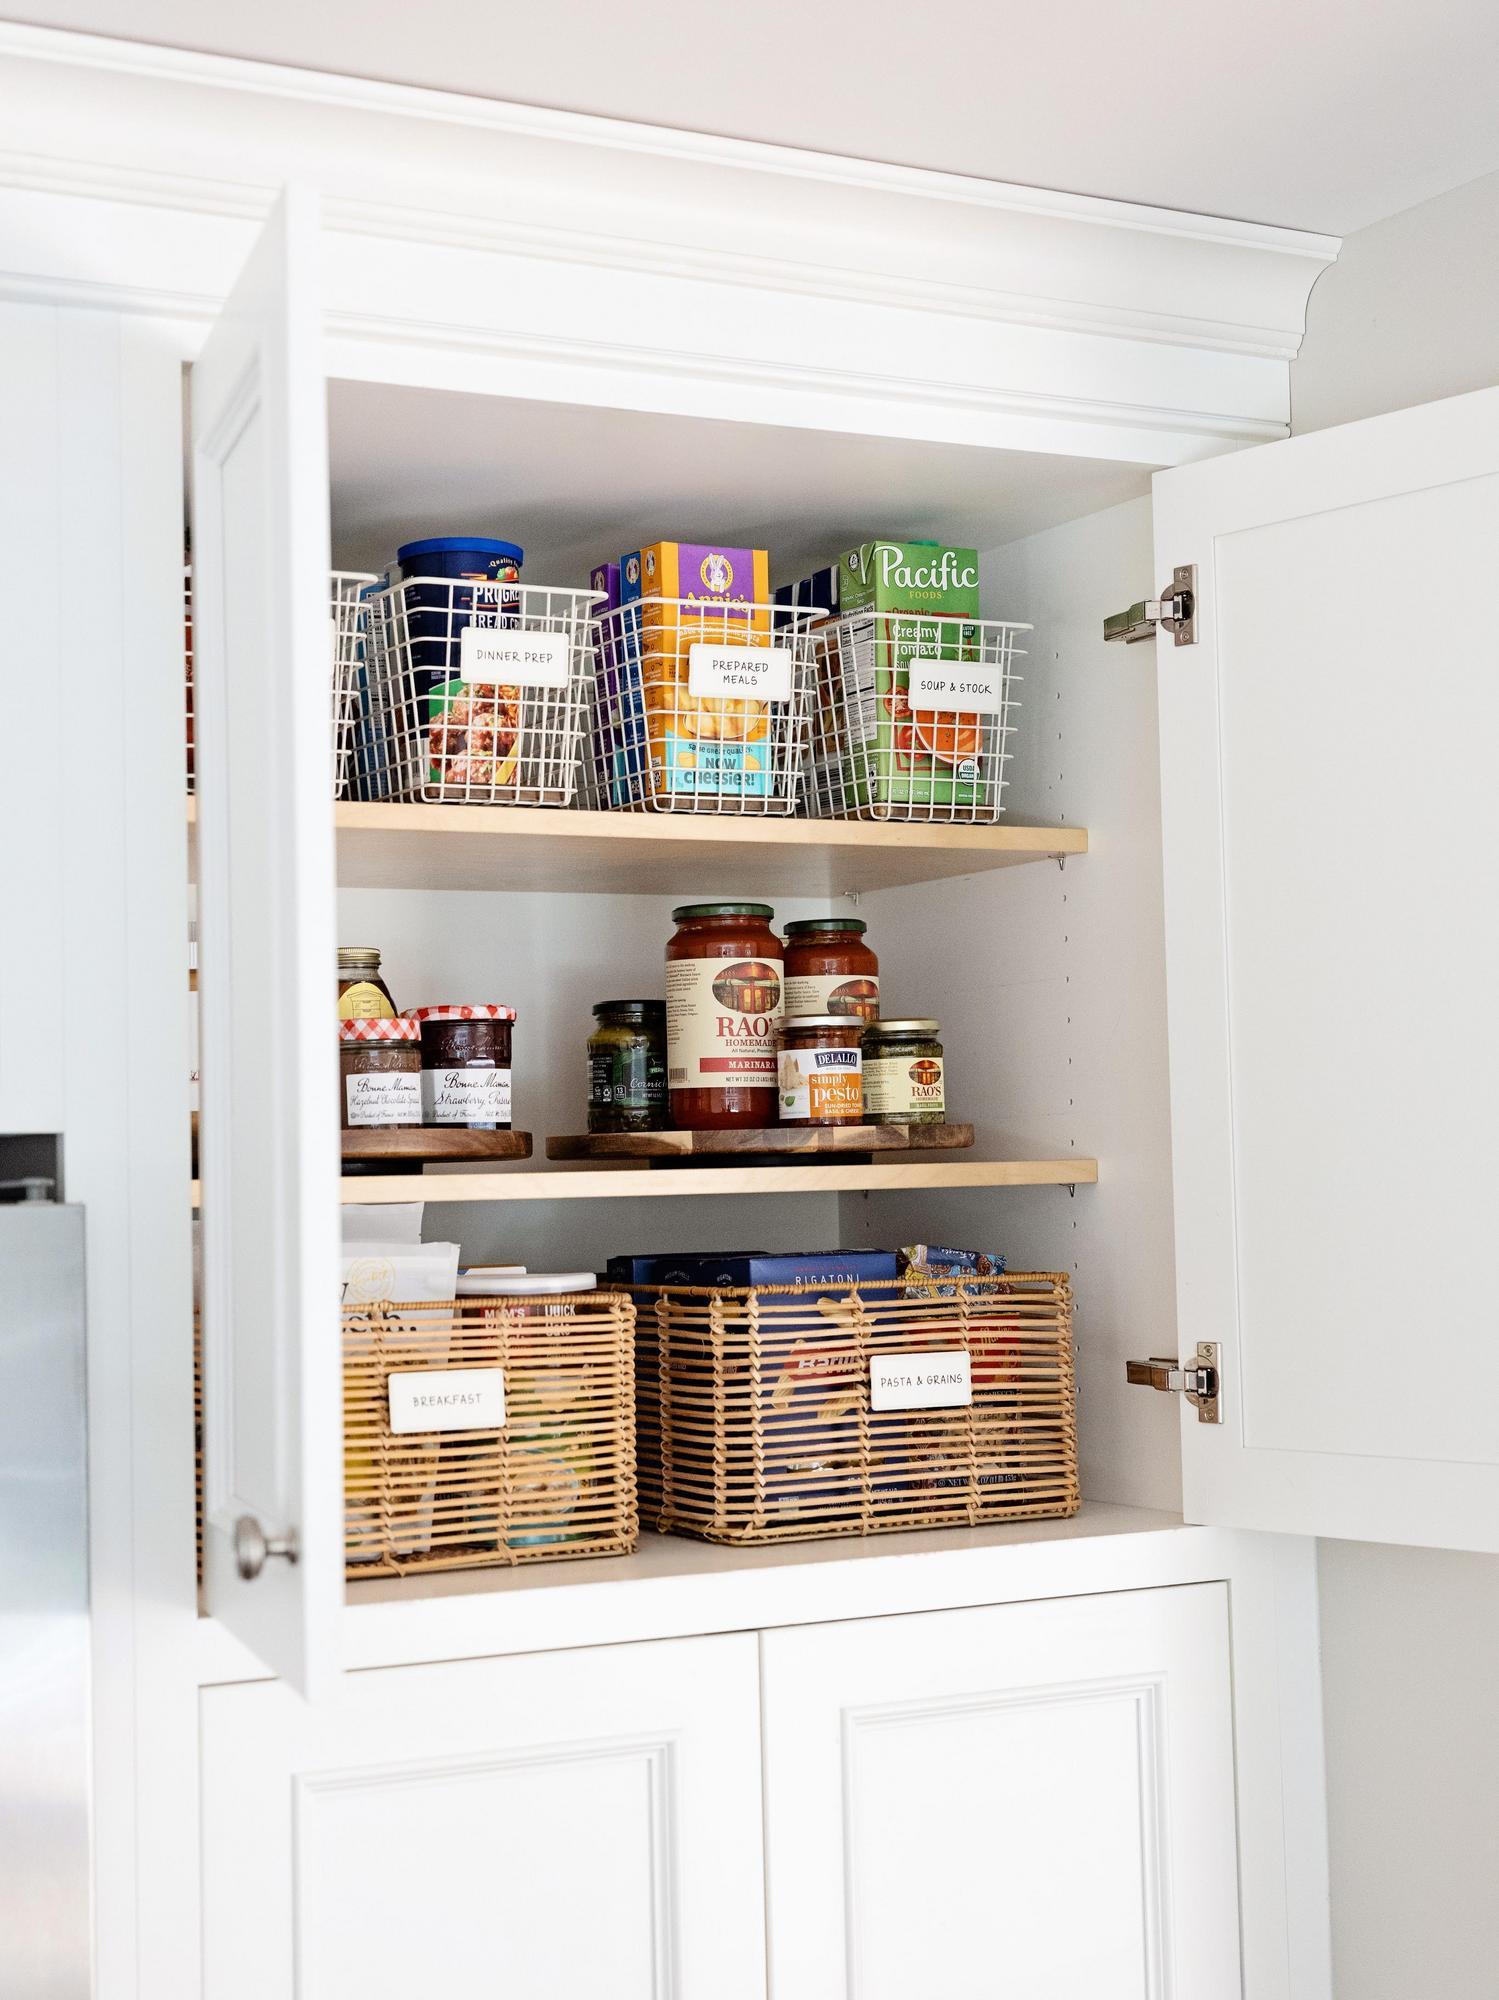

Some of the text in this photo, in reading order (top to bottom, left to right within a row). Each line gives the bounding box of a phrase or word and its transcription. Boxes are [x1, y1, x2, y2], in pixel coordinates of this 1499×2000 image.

[873, 545, 979, 591] Pacific
[893, 623, 940, 642] Creamy
[477, 650, 553, 663] DINNER PREP
[712, 660, 769, 672] PREPARED
[723, 675, 758, 685] MEALS
[921, 681, 992, 694] SOUP & STOCK
[705, 758, 736, 769] NOW
[716, 1017, 773, 1038] RAO'
[728, 1061, 776, 1069] MARINARA
[818, 1053, 856, 1065] DELALLO
[357, 1078, 416, 1092] Bonne Maman
[444, 1072, 510, 1088] Bonne Maman
[811, 1074, 848, 1087] simply
[812, 1085, 859, 1108] pesto
[912, 1087, 942, 1097] RAO'S
[433, 1090, 485, 1109] Strawberry
[795, 1273, 860, 1286] RIGATONI
[880, 1373, 963, 1388] PASTA & GRAINS
[412, 1393, 483, 1408] BREAKFAST
